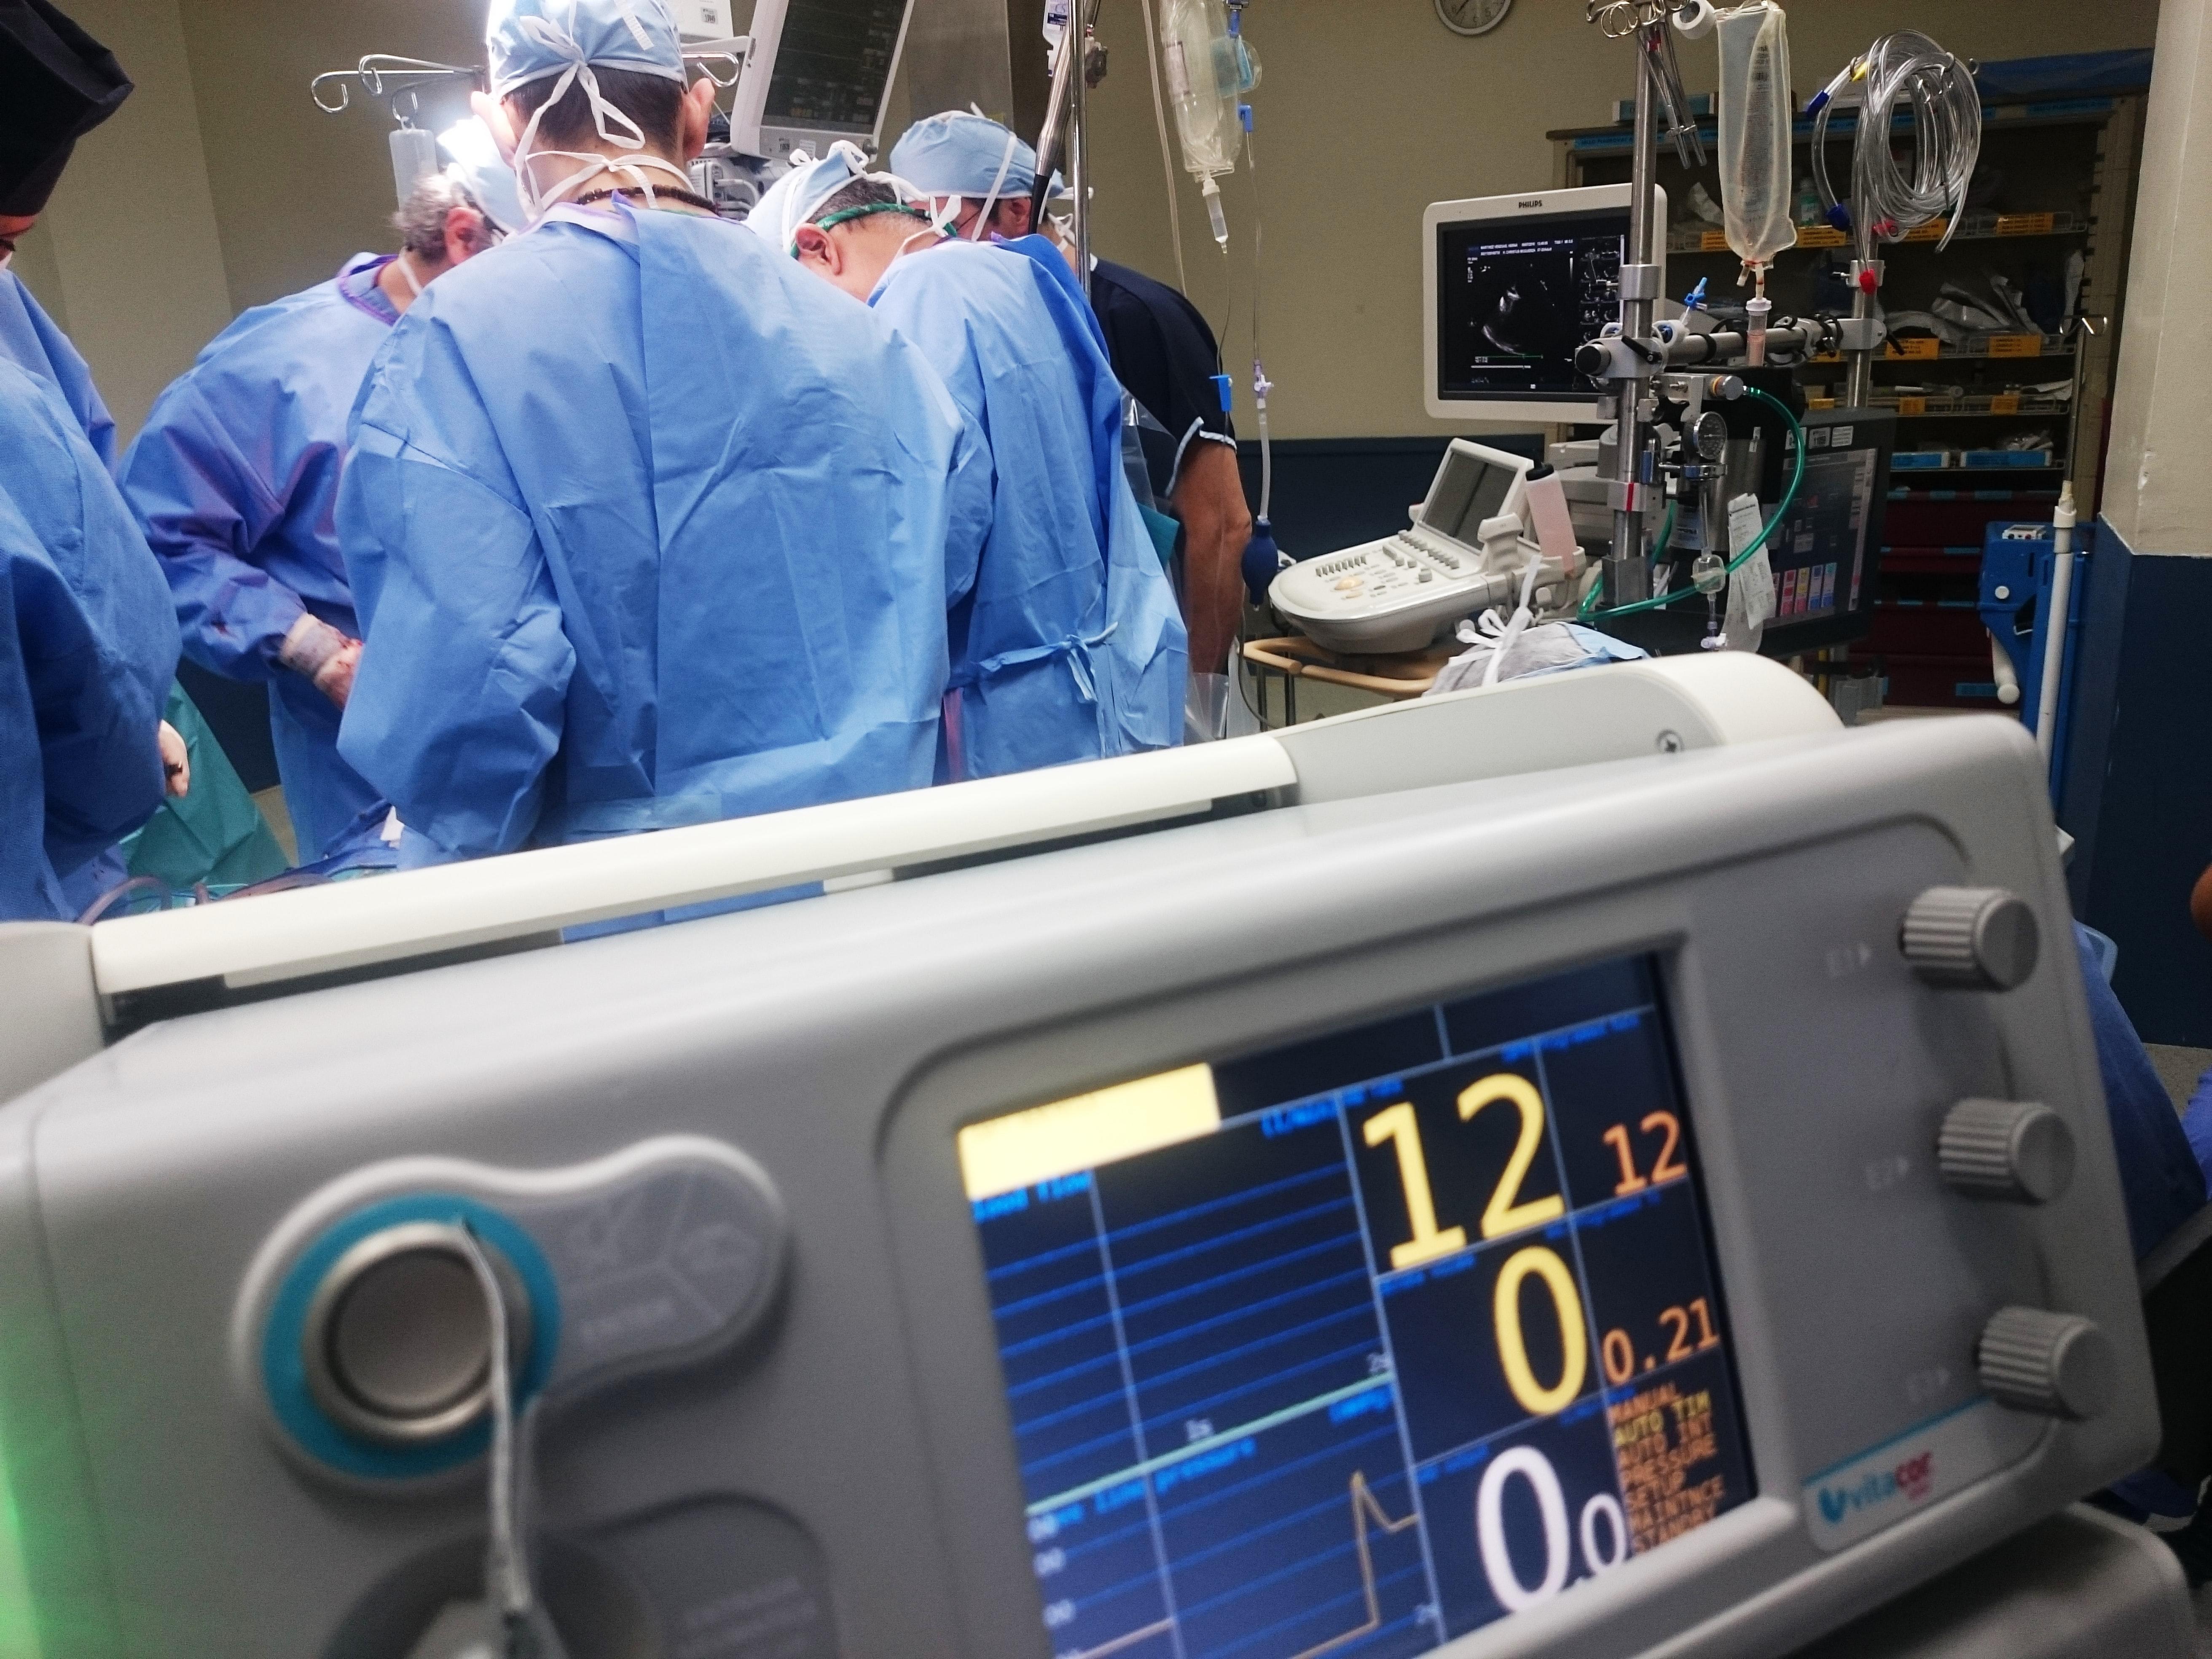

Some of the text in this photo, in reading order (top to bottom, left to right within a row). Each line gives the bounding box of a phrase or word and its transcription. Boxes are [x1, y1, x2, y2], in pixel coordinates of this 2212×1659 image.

[1518, 199, 1543, 209] PHILIPS
[1362, 1072, 1565, 1270] 12
[1603, 1110, 1688, 1196] 12
[1493, 1246, 1588, 1416] 0
[1602, 1297, 1720, 1386] 0.21
